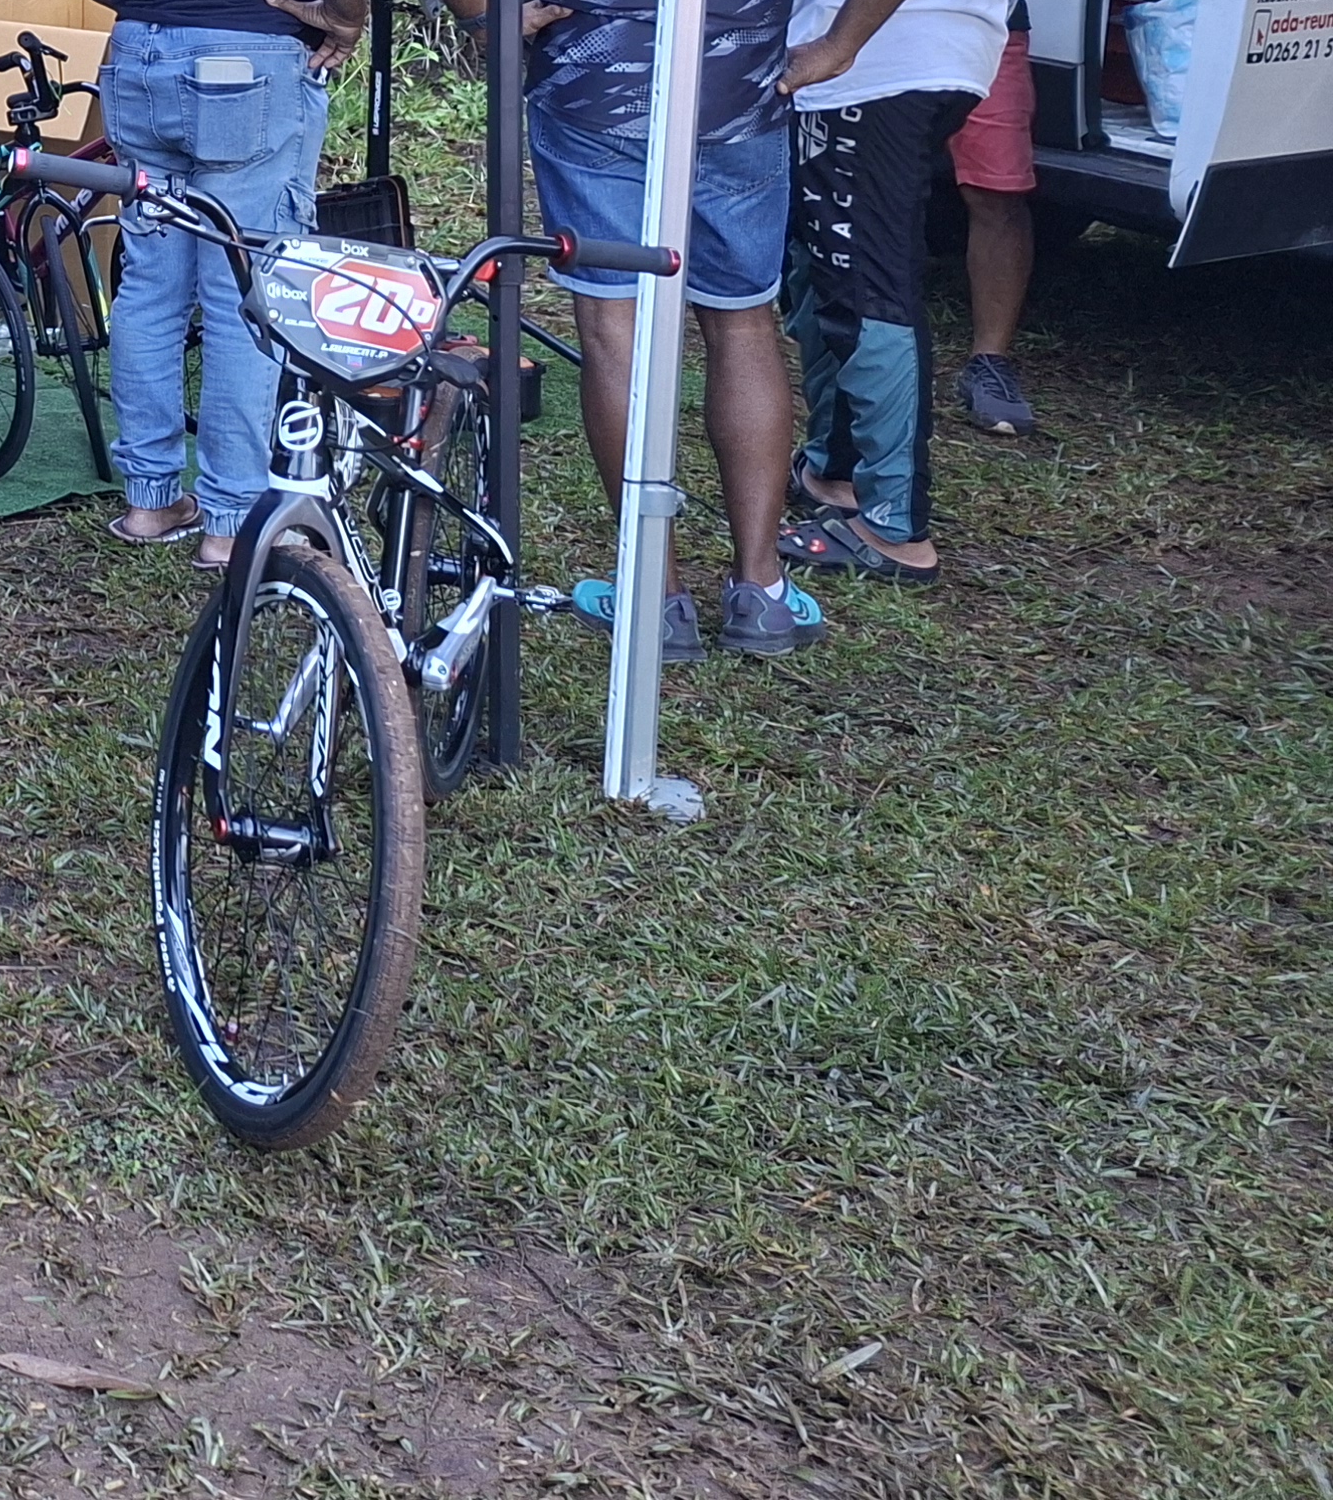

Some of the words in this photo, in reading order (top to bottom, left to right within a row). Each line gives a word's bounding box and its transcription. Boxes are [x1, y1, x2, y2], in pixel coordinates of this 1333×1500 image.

[1264, 41, 1300, 63] 0262
[1302, 39, 1320, 59] 21
[831, 106, 863, 269] RACING
[802, 186, 824, 259] FLY
[341, 241, 369, 257] box
[281, 285, 308, 301] box
